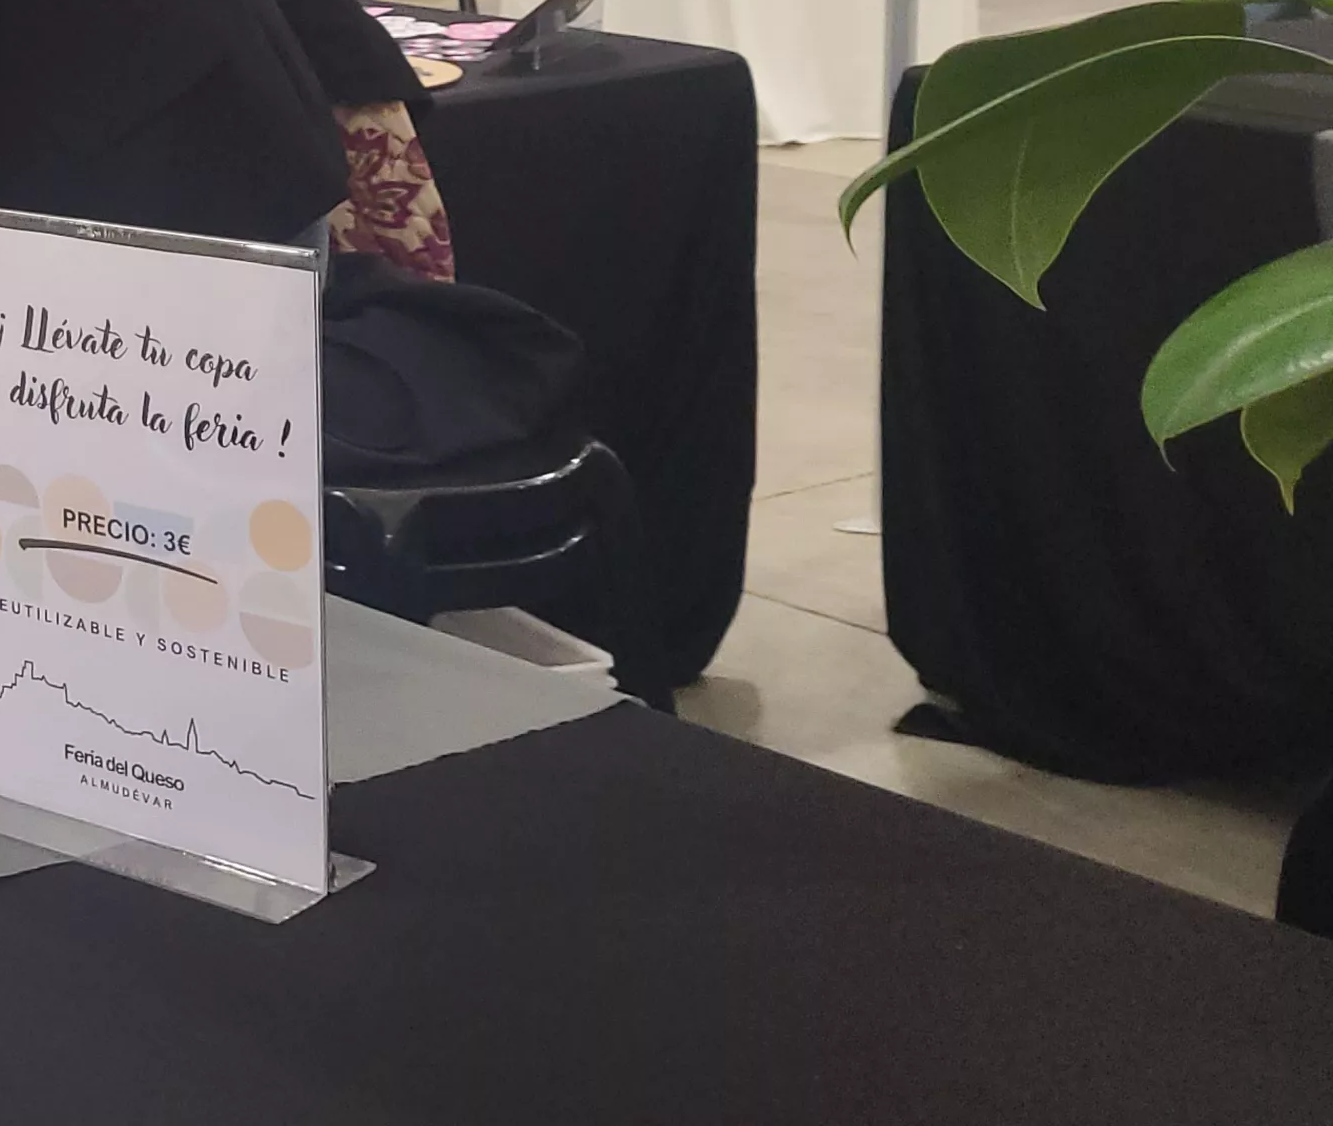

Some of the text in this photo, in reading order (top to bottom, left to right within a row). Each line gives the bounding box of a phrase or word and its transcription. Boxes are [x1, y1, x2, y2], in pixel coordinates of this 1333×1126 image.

[134, 324, 173, 367] tu
[184, 347, 259, 389] copa
[9, 369, 130, 426] disfruta
[141, 390, 173, 434] la
[183, 402, 265, 452] feria
[62, 507, 193, 556] PRECIO: 3€
[135, 631, 147, 647] Y
[156, 637, 290, 683] SOSTENIBLE
[64, 742, 186, 792] Feria del Queso
[79, 773, 173, 810] ALMUDÉVAR
